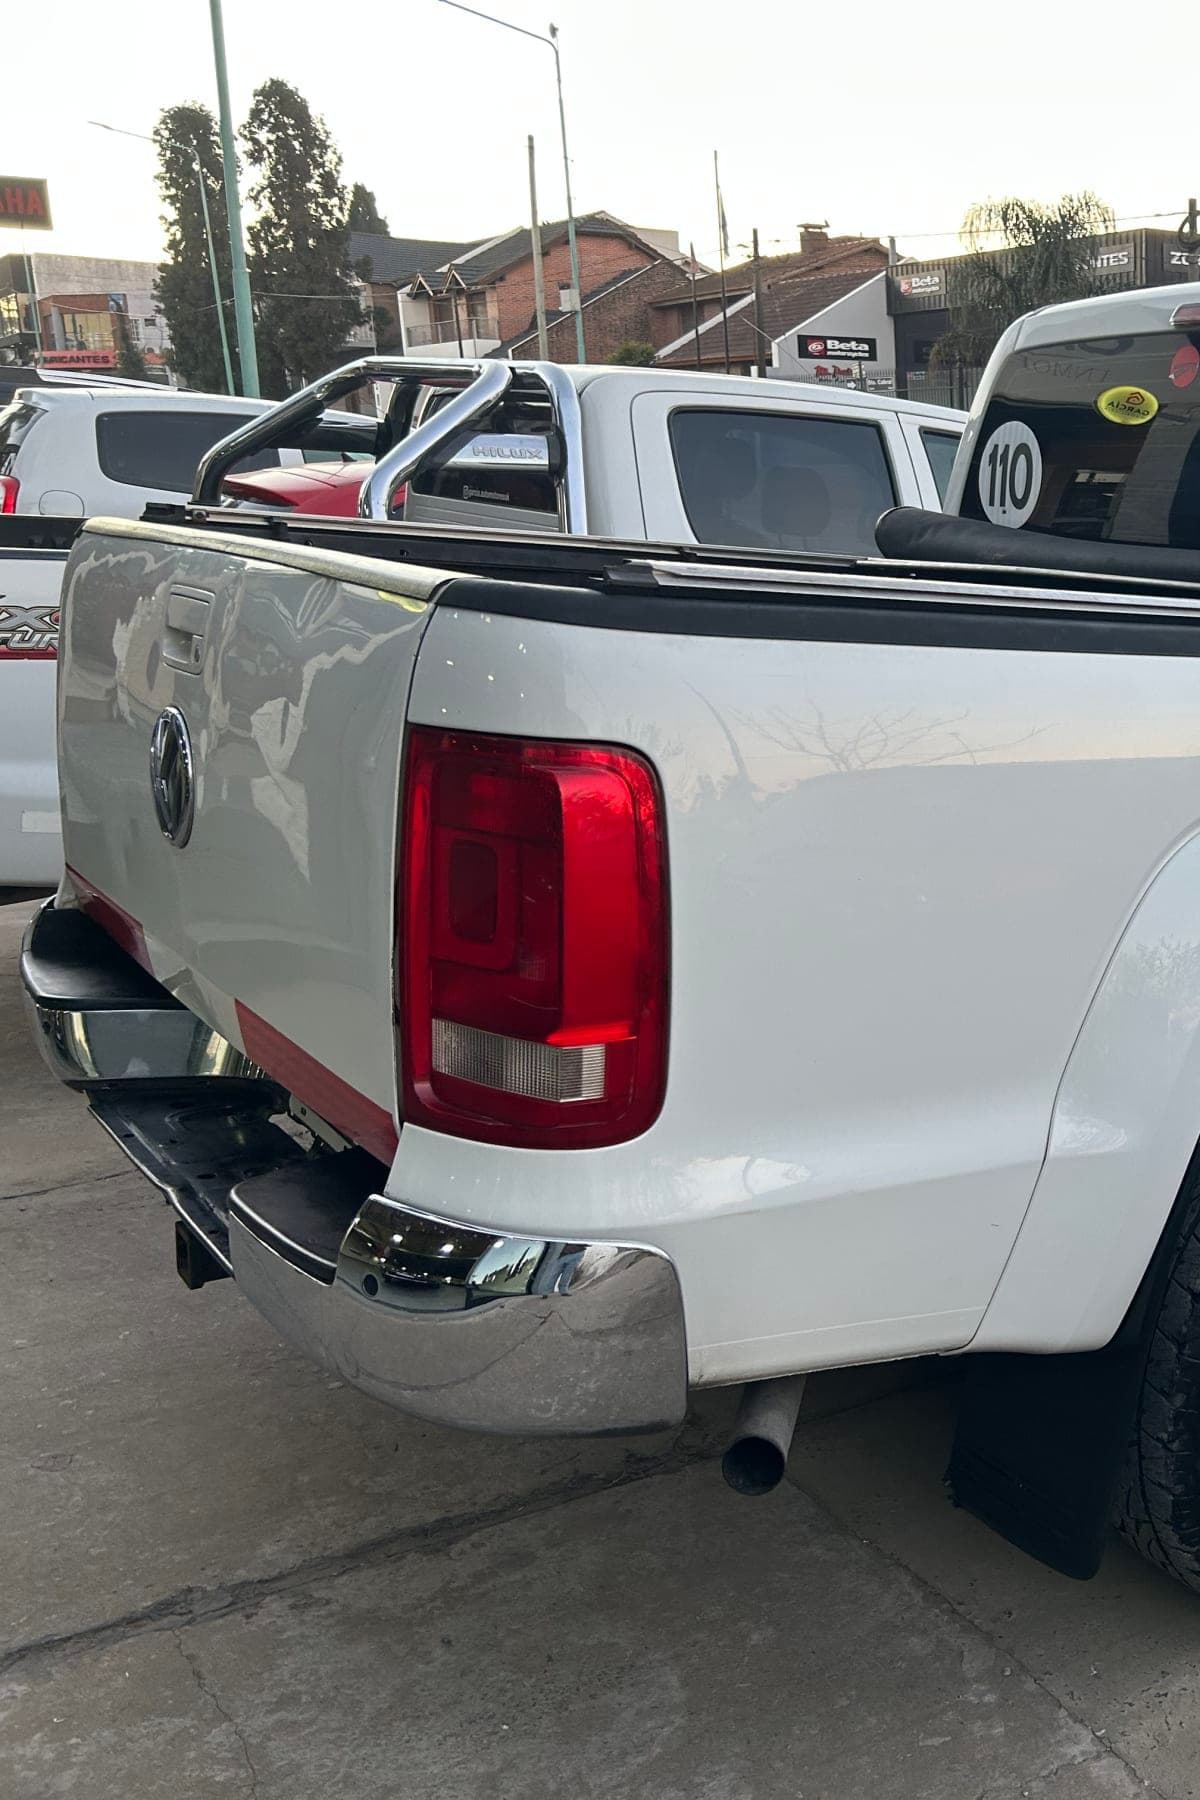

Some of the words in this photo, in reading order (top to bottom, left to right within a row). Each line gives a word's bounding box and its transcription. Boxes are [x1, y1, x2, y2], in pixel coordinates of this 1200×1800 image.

[0, 187, 45, 217] HA
[911, 275, 940, 288] Beta
[826, 339, 870, 351] Beta
[471, 446, 544, 460] HILUX
[988, 442, 1034, 511] 110
